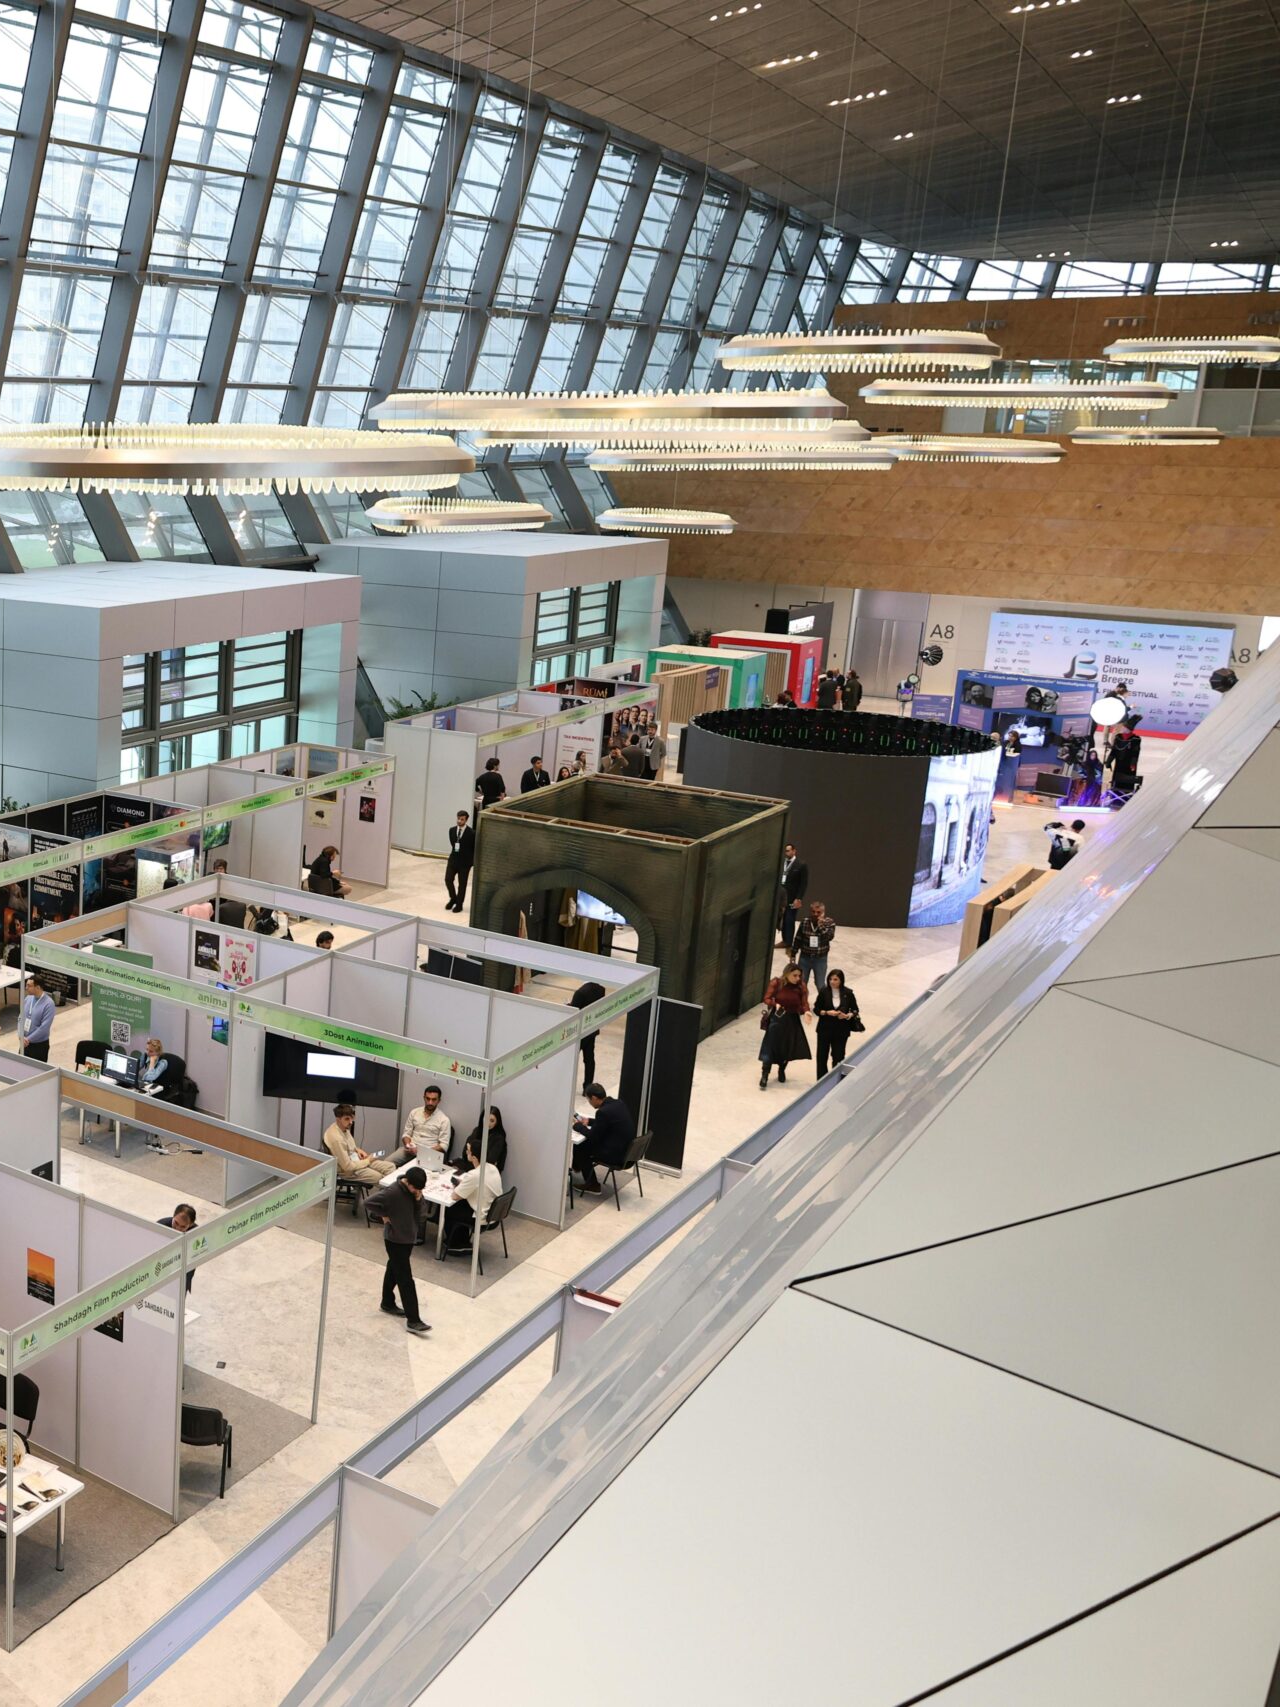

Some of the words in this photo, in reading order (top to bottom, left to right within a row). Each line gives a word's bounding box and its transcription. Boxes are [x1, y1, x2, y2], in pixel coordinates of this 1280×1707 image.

[930, 623, 954, 639] A8
[1104, 654, 1130, 665] Baku
[1102, 664, 1139, 676] Cinema
[1101, 674, 1134, 685] Breeze
[116, 806, 145, 817] DIAMOND
[74, 960, 105, 975] Azerbaijan
[105, 966, 136, 982] Animation
[136, 974, 172, 992] Association
[197, 993, 228, 1008] anima
[324, 1028, 345, 1041] 3Dost
[346, 1032, 384, 1051] Animation
[460, 1065, 486, 1080] 3Dost
[227, 1217, 249, 1235] Chinar
[249, 1210, 264, 1224] Film
[264, 1191, 299, 1216] Production
[53, 1302, 93, 1333] Shahdagh
[93, 1296, 110, 1310] Film
[110, 1272, 150, 1300] Production
[163, 1308, 175, 1320] FILM
